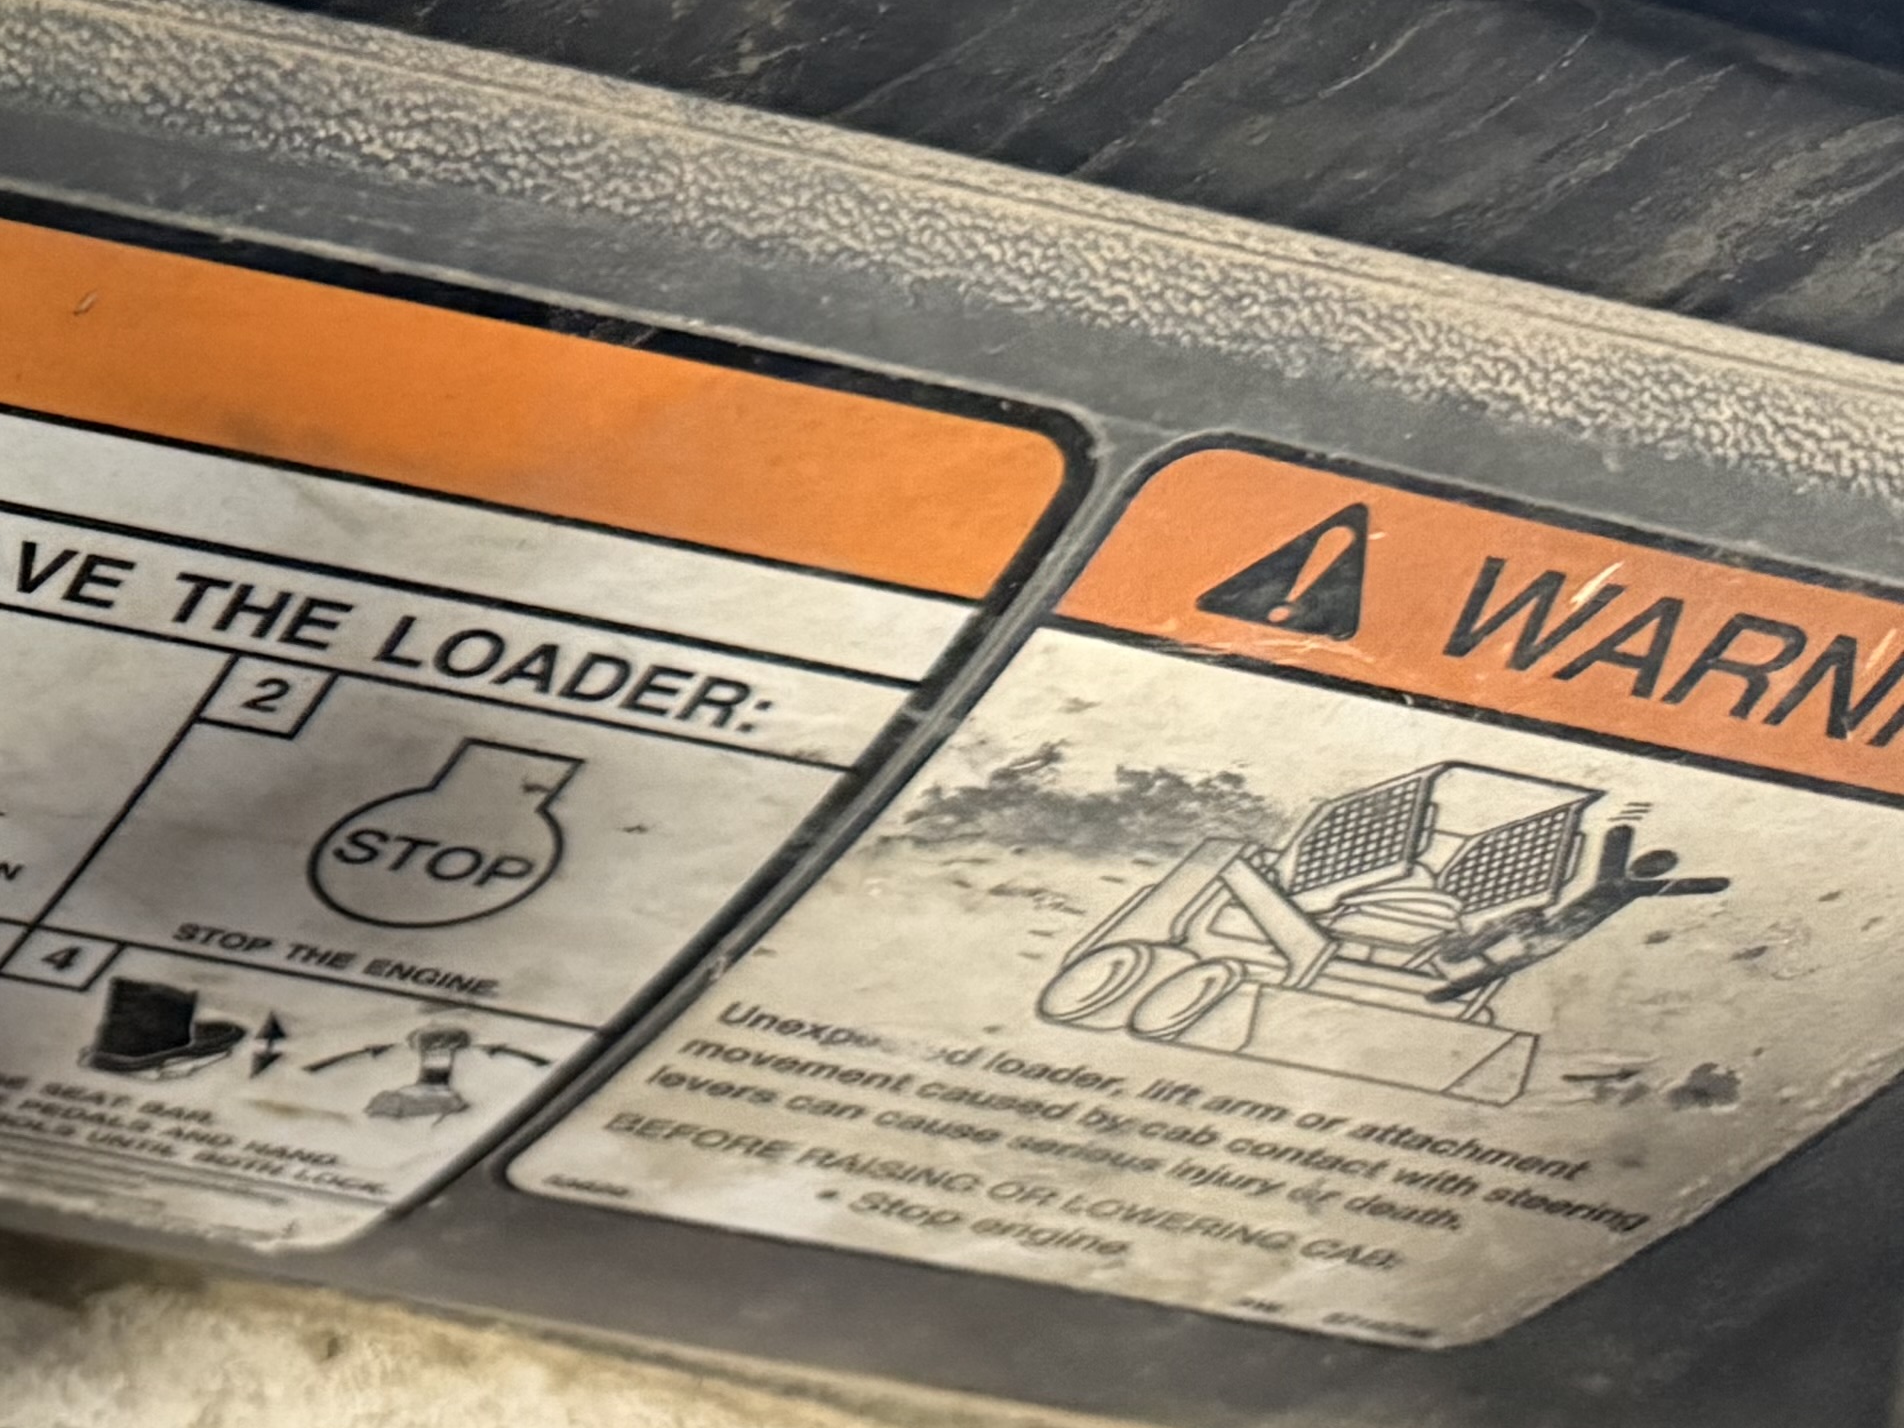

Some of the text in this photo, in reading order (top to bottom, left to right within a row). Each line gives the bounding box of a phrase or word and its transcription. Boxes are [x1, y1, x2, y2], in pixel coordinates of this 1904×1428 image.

[171, 573, 355, 652] THE
[375, 615, 775, 737] LOADER:
[240, 678, 288, 714] 2
[333, 828, 537, 888] STOP
[41, 946, 81, 972] 4
[173, 922, 273, 952] STOP
[285, 943, 357, 970] THE
[41, 1082, 133, 1108] SEAT
[985, 1048, 1126, 1097] loader,
[1136, 1078, 1201, 1106] lift
[1201, 1095, 1289, 1122] arm
[1293, 1110, 1346, 1132] or
[1348, 1120, 1594, 1182] attachment
[18, 1098, 152, 1133] PEDALS
[160, 1125, 237, 1148] AND
[242, 1139, 340, 1167] HAND
[86, 1129, 178, 1158] UNTIL
[647, 1064, 1463, 1232] levers can cause serious injury or death.
[679, 1037, 1650, 1234] movement caused by cab contact with steering
[603, 1111, 796, 1161] BEFORE
[796, 1146, 982, 1194] RAISING
[987, 1180, 1059, 1207] OR
[1060, 1193, 1297, 1251] LOWERING
[849, 1191, 964, 1229] Stop
